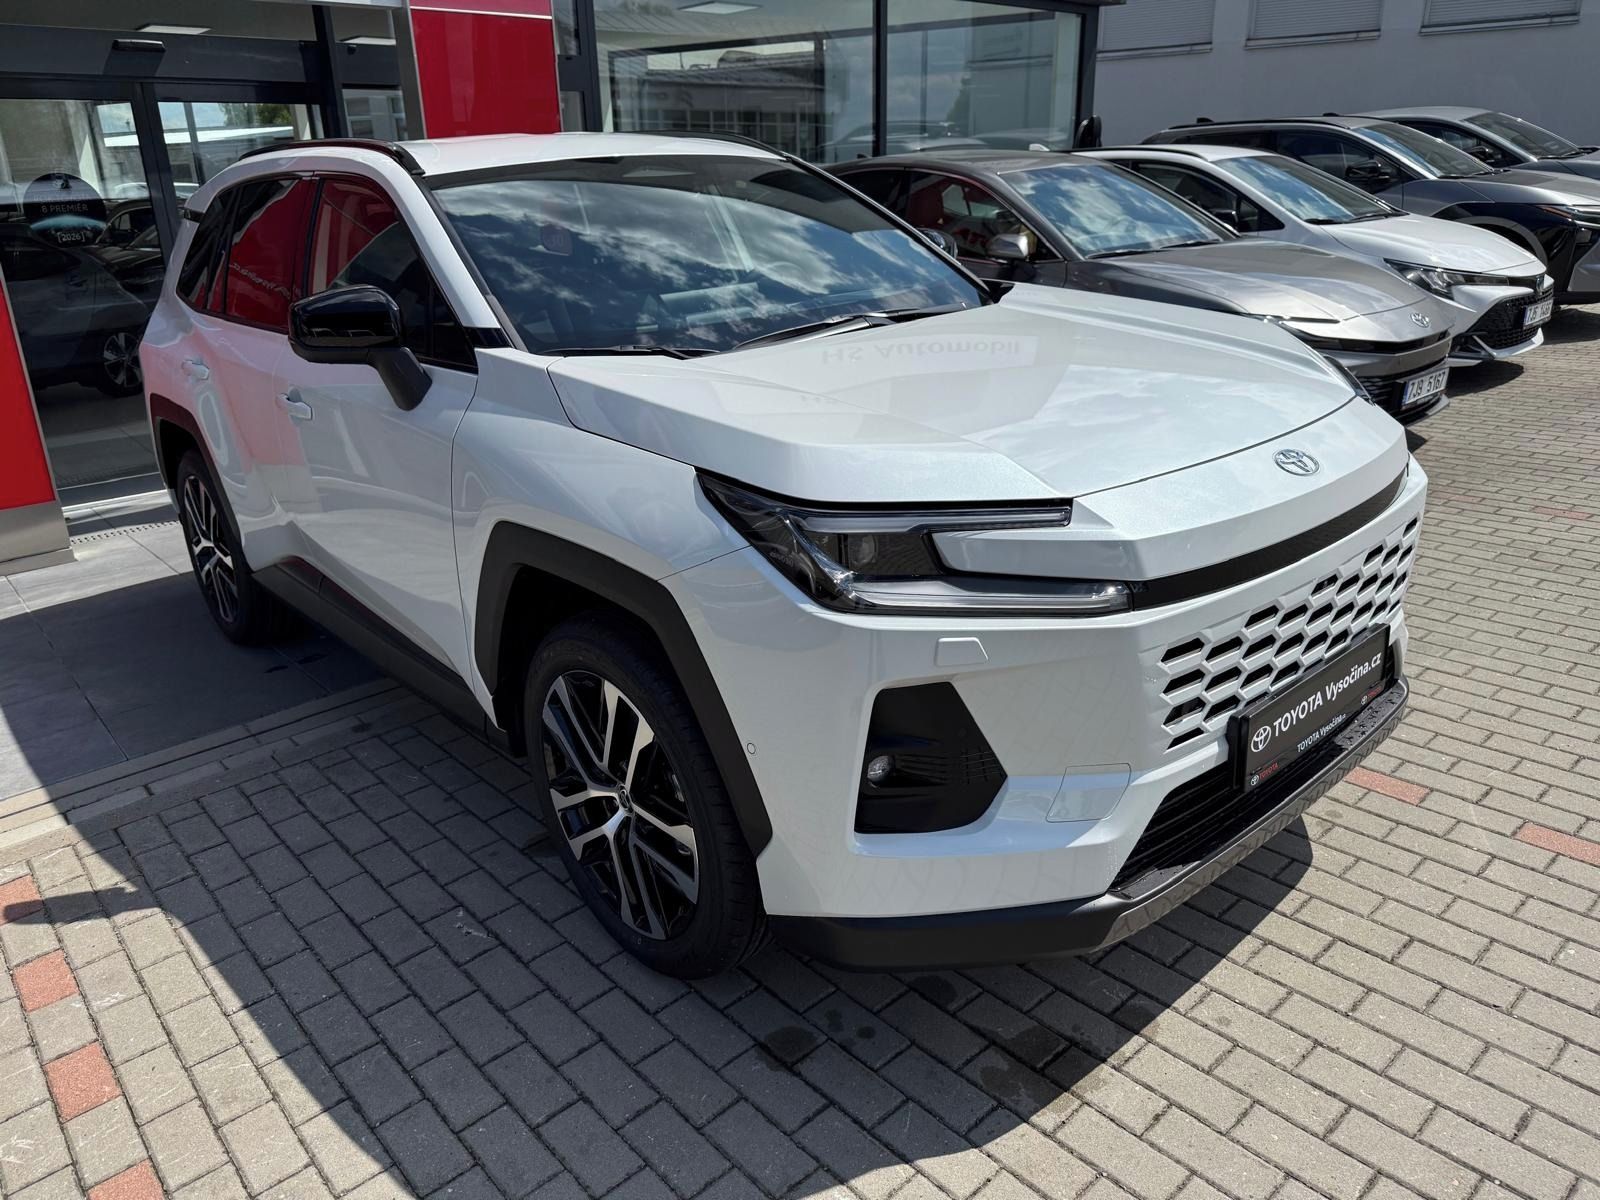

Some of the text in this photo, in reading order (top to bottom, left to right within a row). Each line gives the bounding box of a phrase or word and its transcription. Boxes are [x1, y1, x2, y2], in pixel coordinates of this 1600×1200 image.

[50, 203, 88, 213] PREMIÉR
[1408, 371, 1446, 400] 7J9 5167
[1273, 652, 1382, 737] TOYOTA Vysočina.cz
[1297, 731, 1320, 752] TOYOTA
